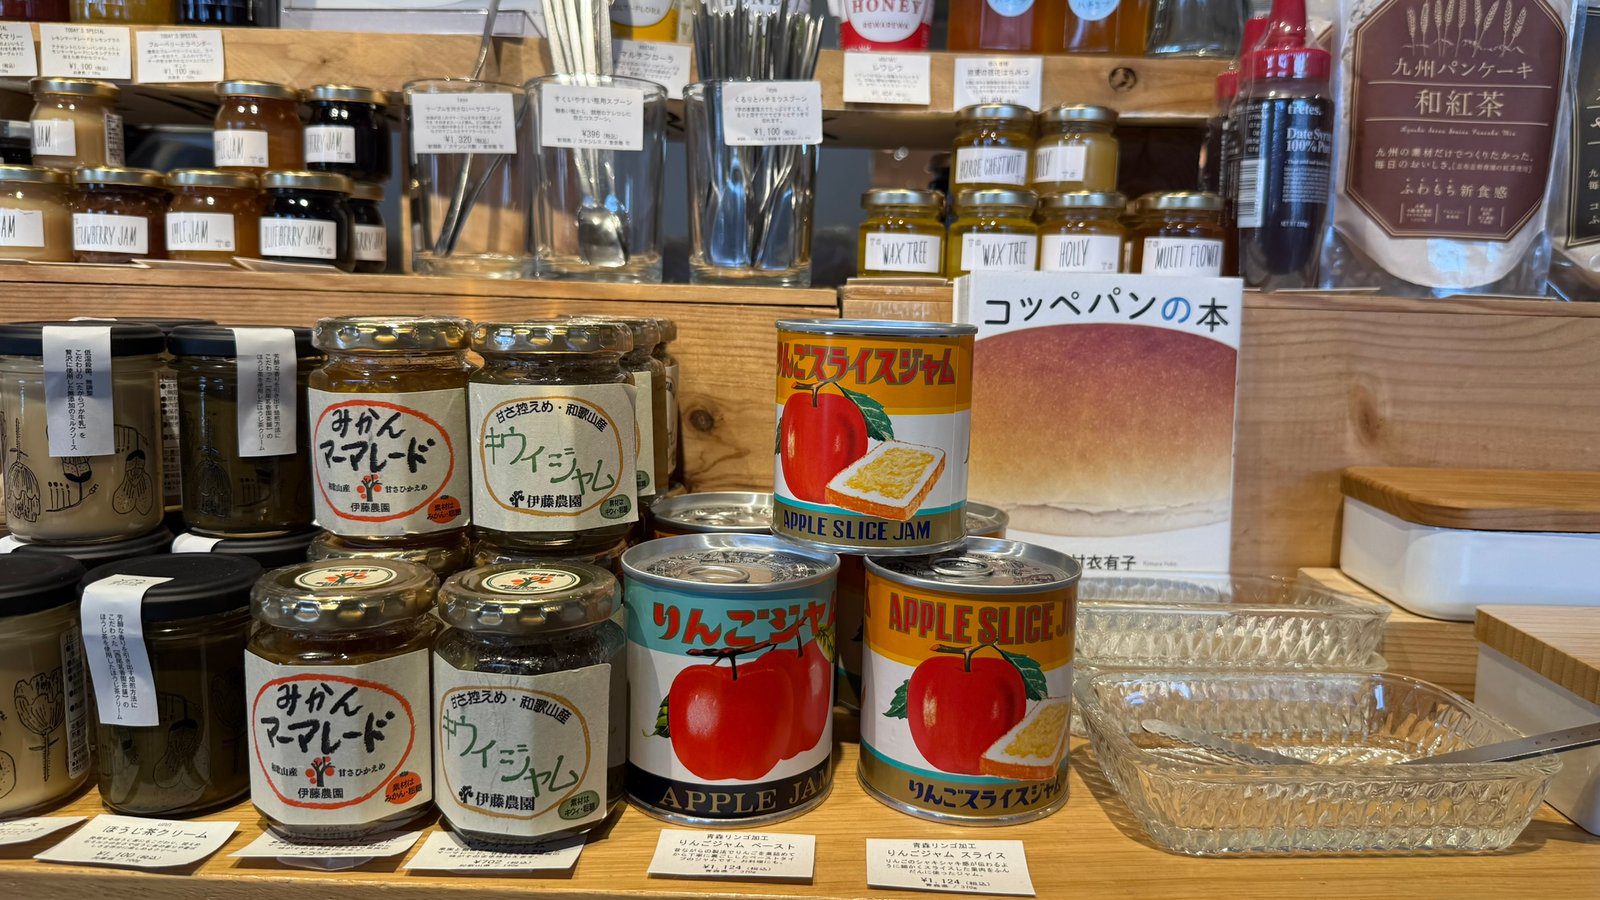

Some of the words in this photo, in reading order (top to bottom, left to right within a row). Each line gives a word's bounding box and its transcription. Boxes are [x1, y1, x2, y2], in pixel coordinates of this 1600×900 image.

[1391, 57, 1534, 80] 九州パンケーキ
[1413, 88, 1505, 119] 和紅茶
[582, 129, 601, 139] ¥396
[1286, 127, 1313, 139] Date
[1285, 140, 1316, 153] 100%
[1400, 183, 1509, 200] ふわもち新食感
[117, 225, 137, 247] JAM
[189, 220, 209, 244] JAM
[305, 225, 325, 247] JAM
[882, 241, 904, 265] WAX
[906, 241, 929, 265] TREE
[982, 243, 1006, 267] WAX
[1007, 241, 1027, 265] TREE
[1059, 238, 1089, 268] HOLLY
[1155, 245, 1184, 270] MULTI
[984, 287, 1229, 333] コッペパンの本
[331, 408, 406, 439] みかん
[319, 436, 437, 474] マーマレード
[385, 483, 428, 493] 甘さひかえめ
[350, 502, 391, 513] 伊藤農園
[526, 494, 583, 508] 伊藤農園
[783, 508, 829, 537] APPLE
[832, 518, 888, 541] SLICE
[892, 519, 931, 541] JAM
[888, 592, 974, 644] APPLE
[977, 603, 1055, 645] SLICE
[276, 683, 363, 717] みかん
[261, 710, 396, 754] マーマレード
[338, 762, 387, 777] 甘さひかえめ
[297, 787, 345, 799] 伊藤農園
[475, 792, 535, 812] 伊藤農園
[659, 786, 778, 814] APPLE
[908, 776, 1061, 809] りんごスライスジャム
[102, 825, 208, 839] ほうじ茶クリーム
[706, 833, 769, 841] 青森リンゴ加工
[680, 839, 745, 849] りんごジャム
[751, 842, 796, 851] ペースト
[887, 849, 955, 858] りんごジャム
[961, 850, 1006, 859] スライス
